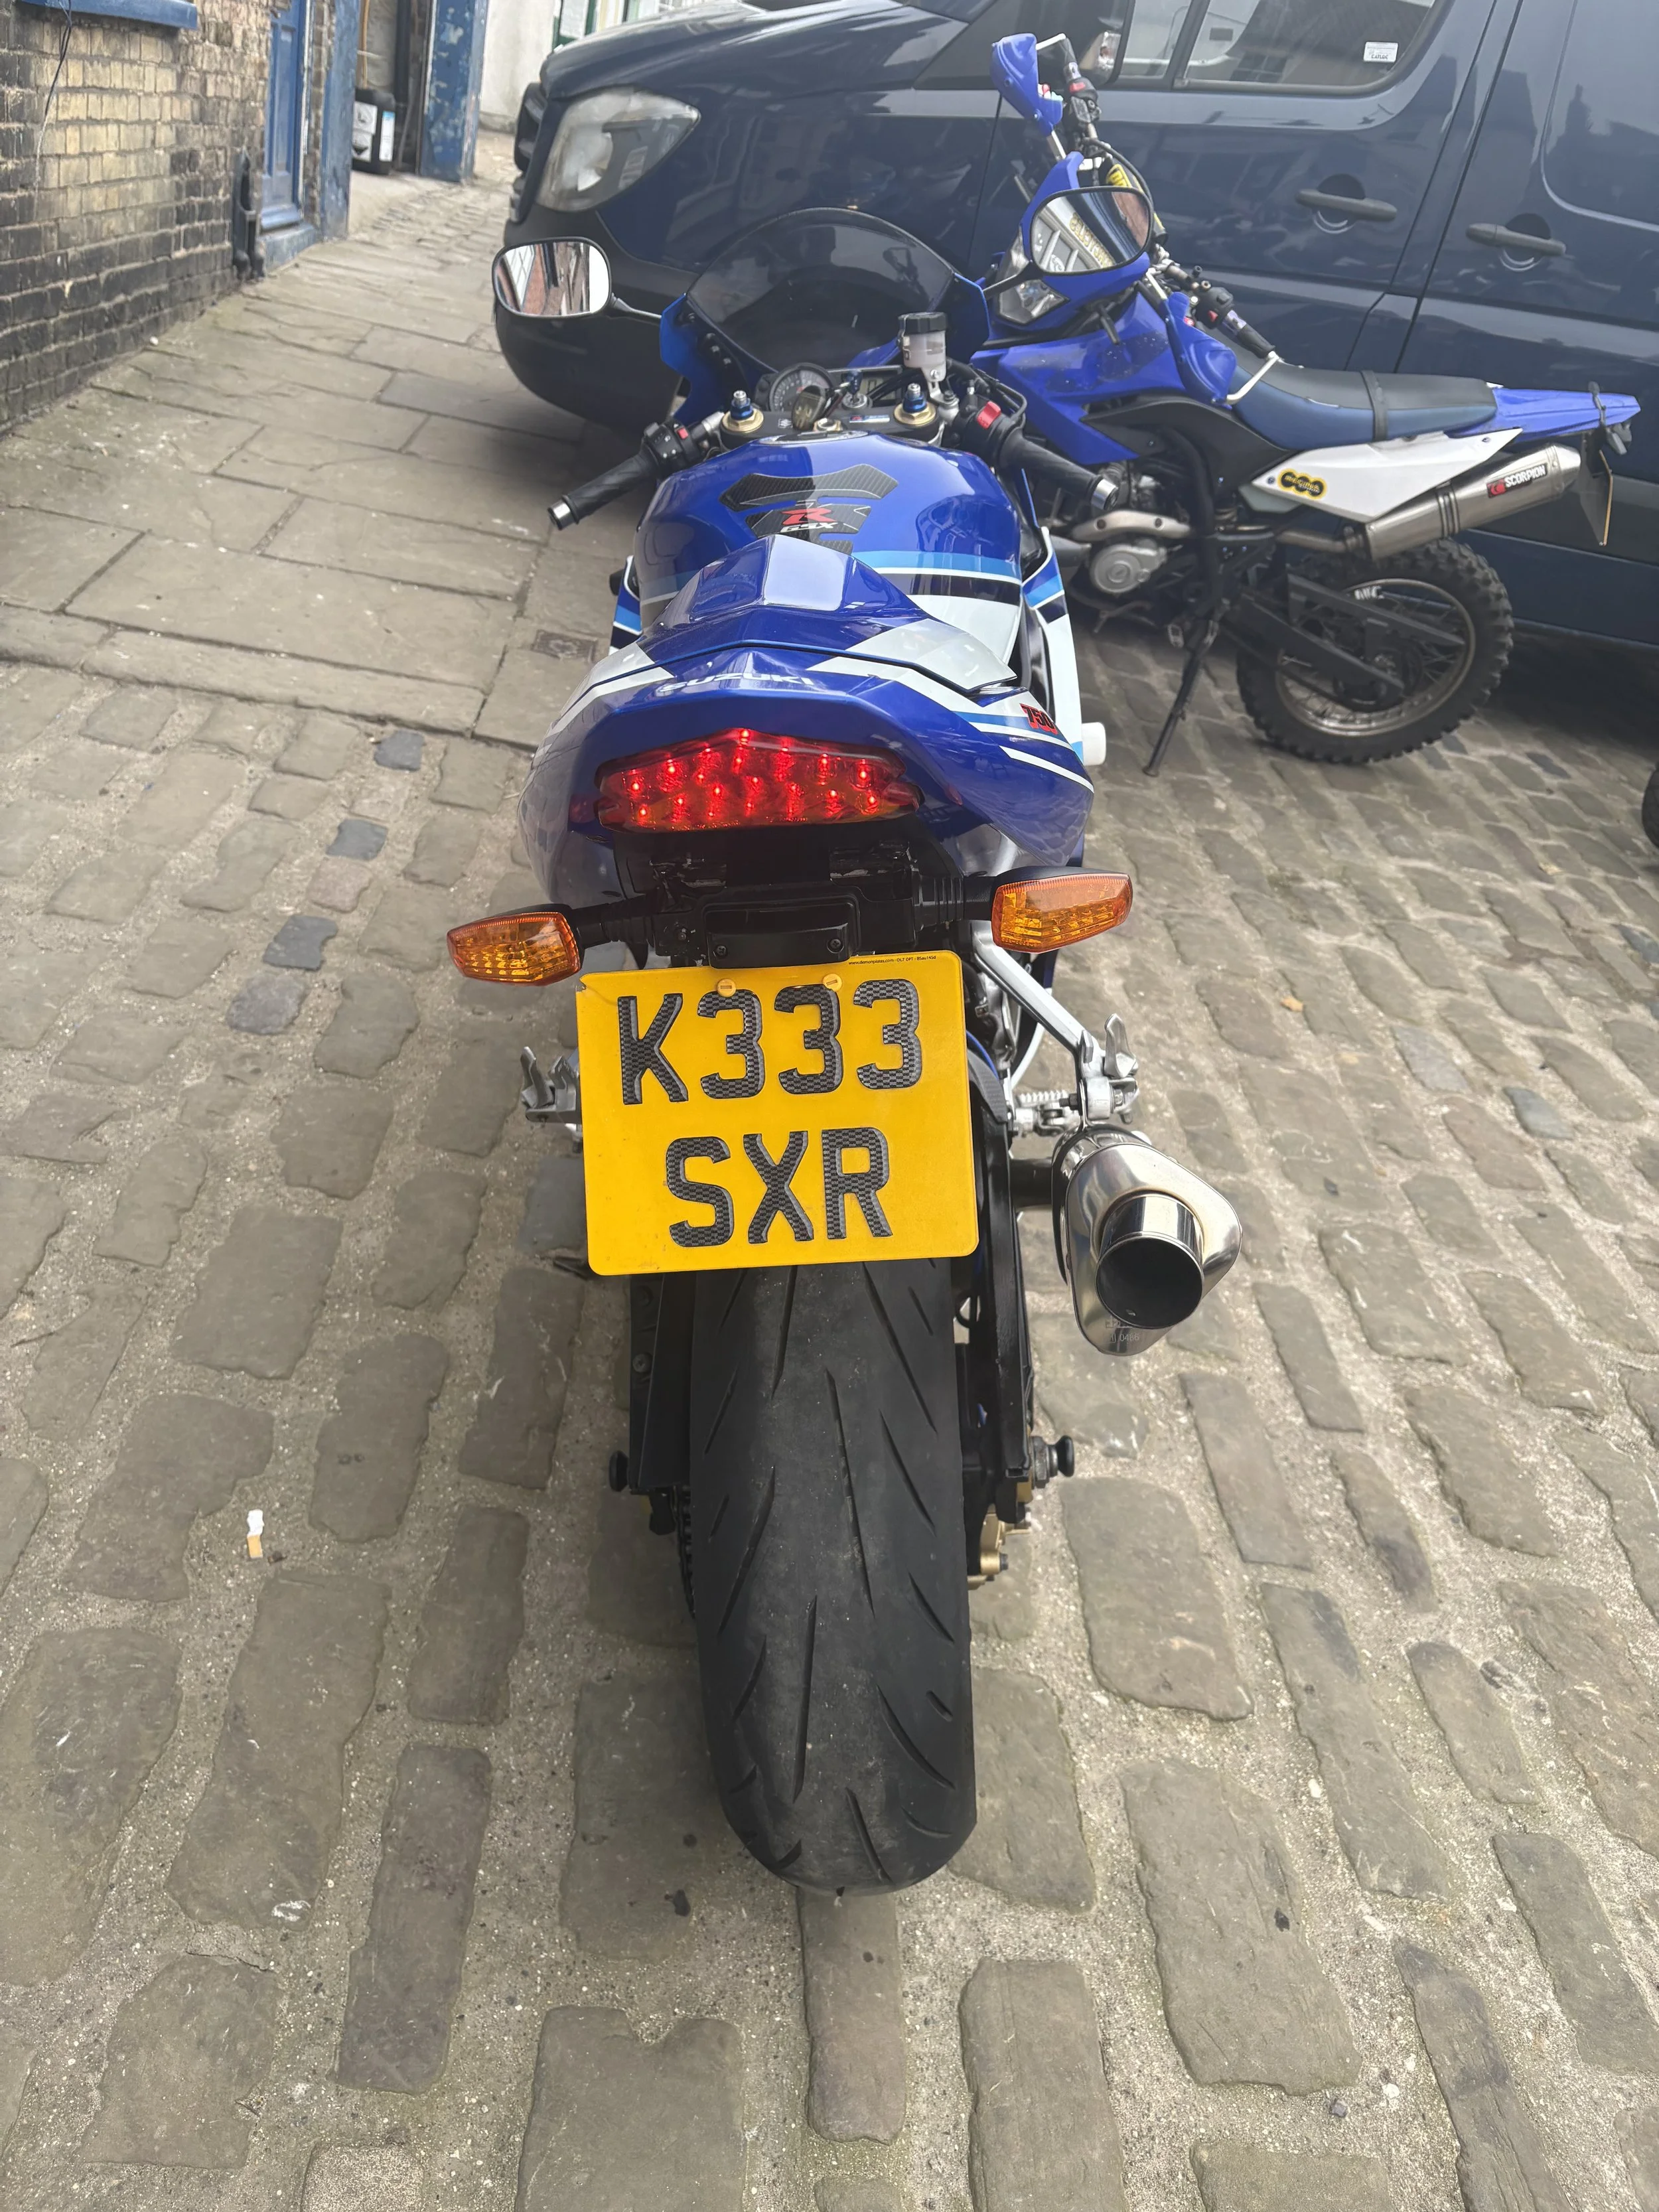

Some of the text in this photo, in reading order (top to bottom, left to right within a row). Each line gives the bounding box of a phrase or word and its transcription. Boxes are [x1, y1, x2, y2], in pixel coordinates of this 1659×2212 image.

[1504, 464, 1547, 488] SCORPION
[779, 522, 839, 532] GSX
[656, 672, 814, 693] SUZUKI
[1019, 703, 1058, 735] 750
[617, 978, 923, 1105] K333
[666, 1126, 894, 1248] SXR
